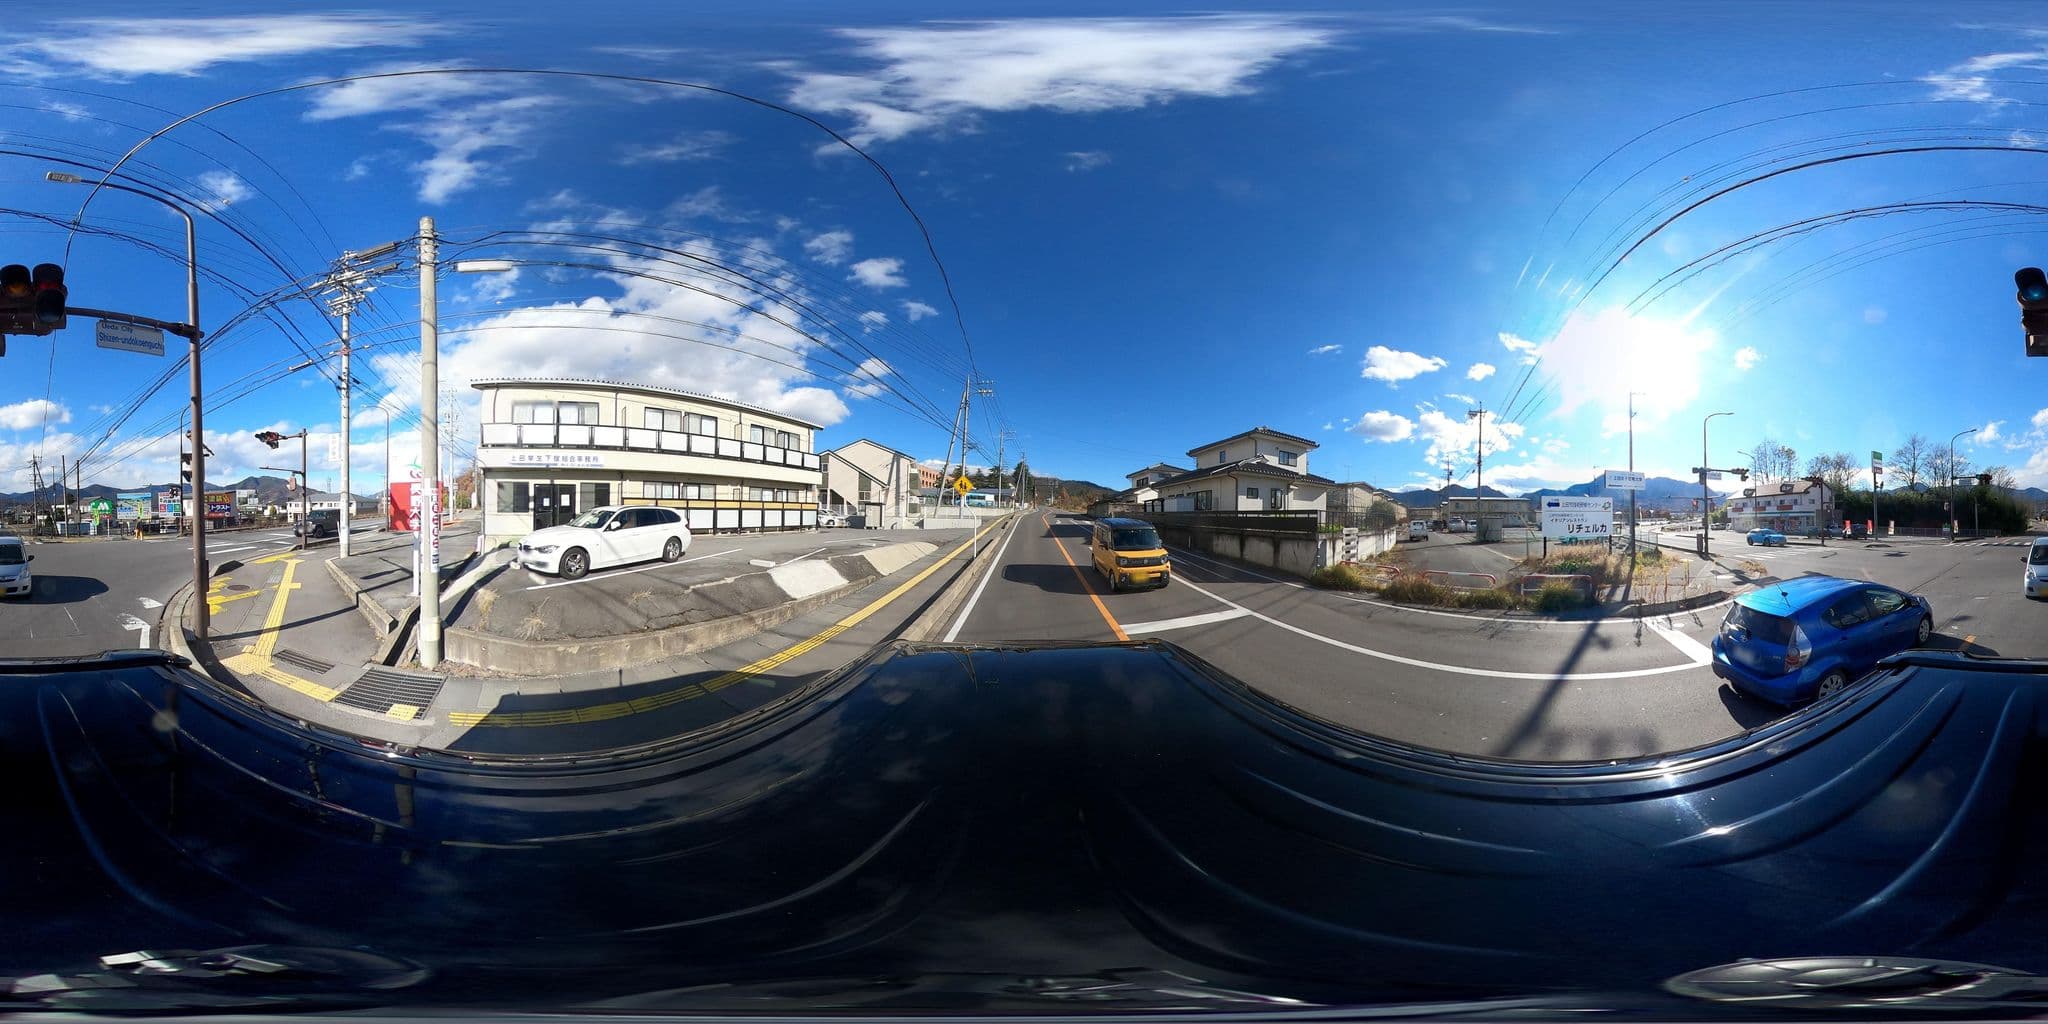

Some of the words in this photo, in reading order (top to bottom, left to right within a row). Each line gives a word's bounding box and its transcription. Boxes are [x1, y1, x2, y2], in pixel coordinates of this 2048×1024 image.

[1567, 523, 1608, 534] リチェルカ
